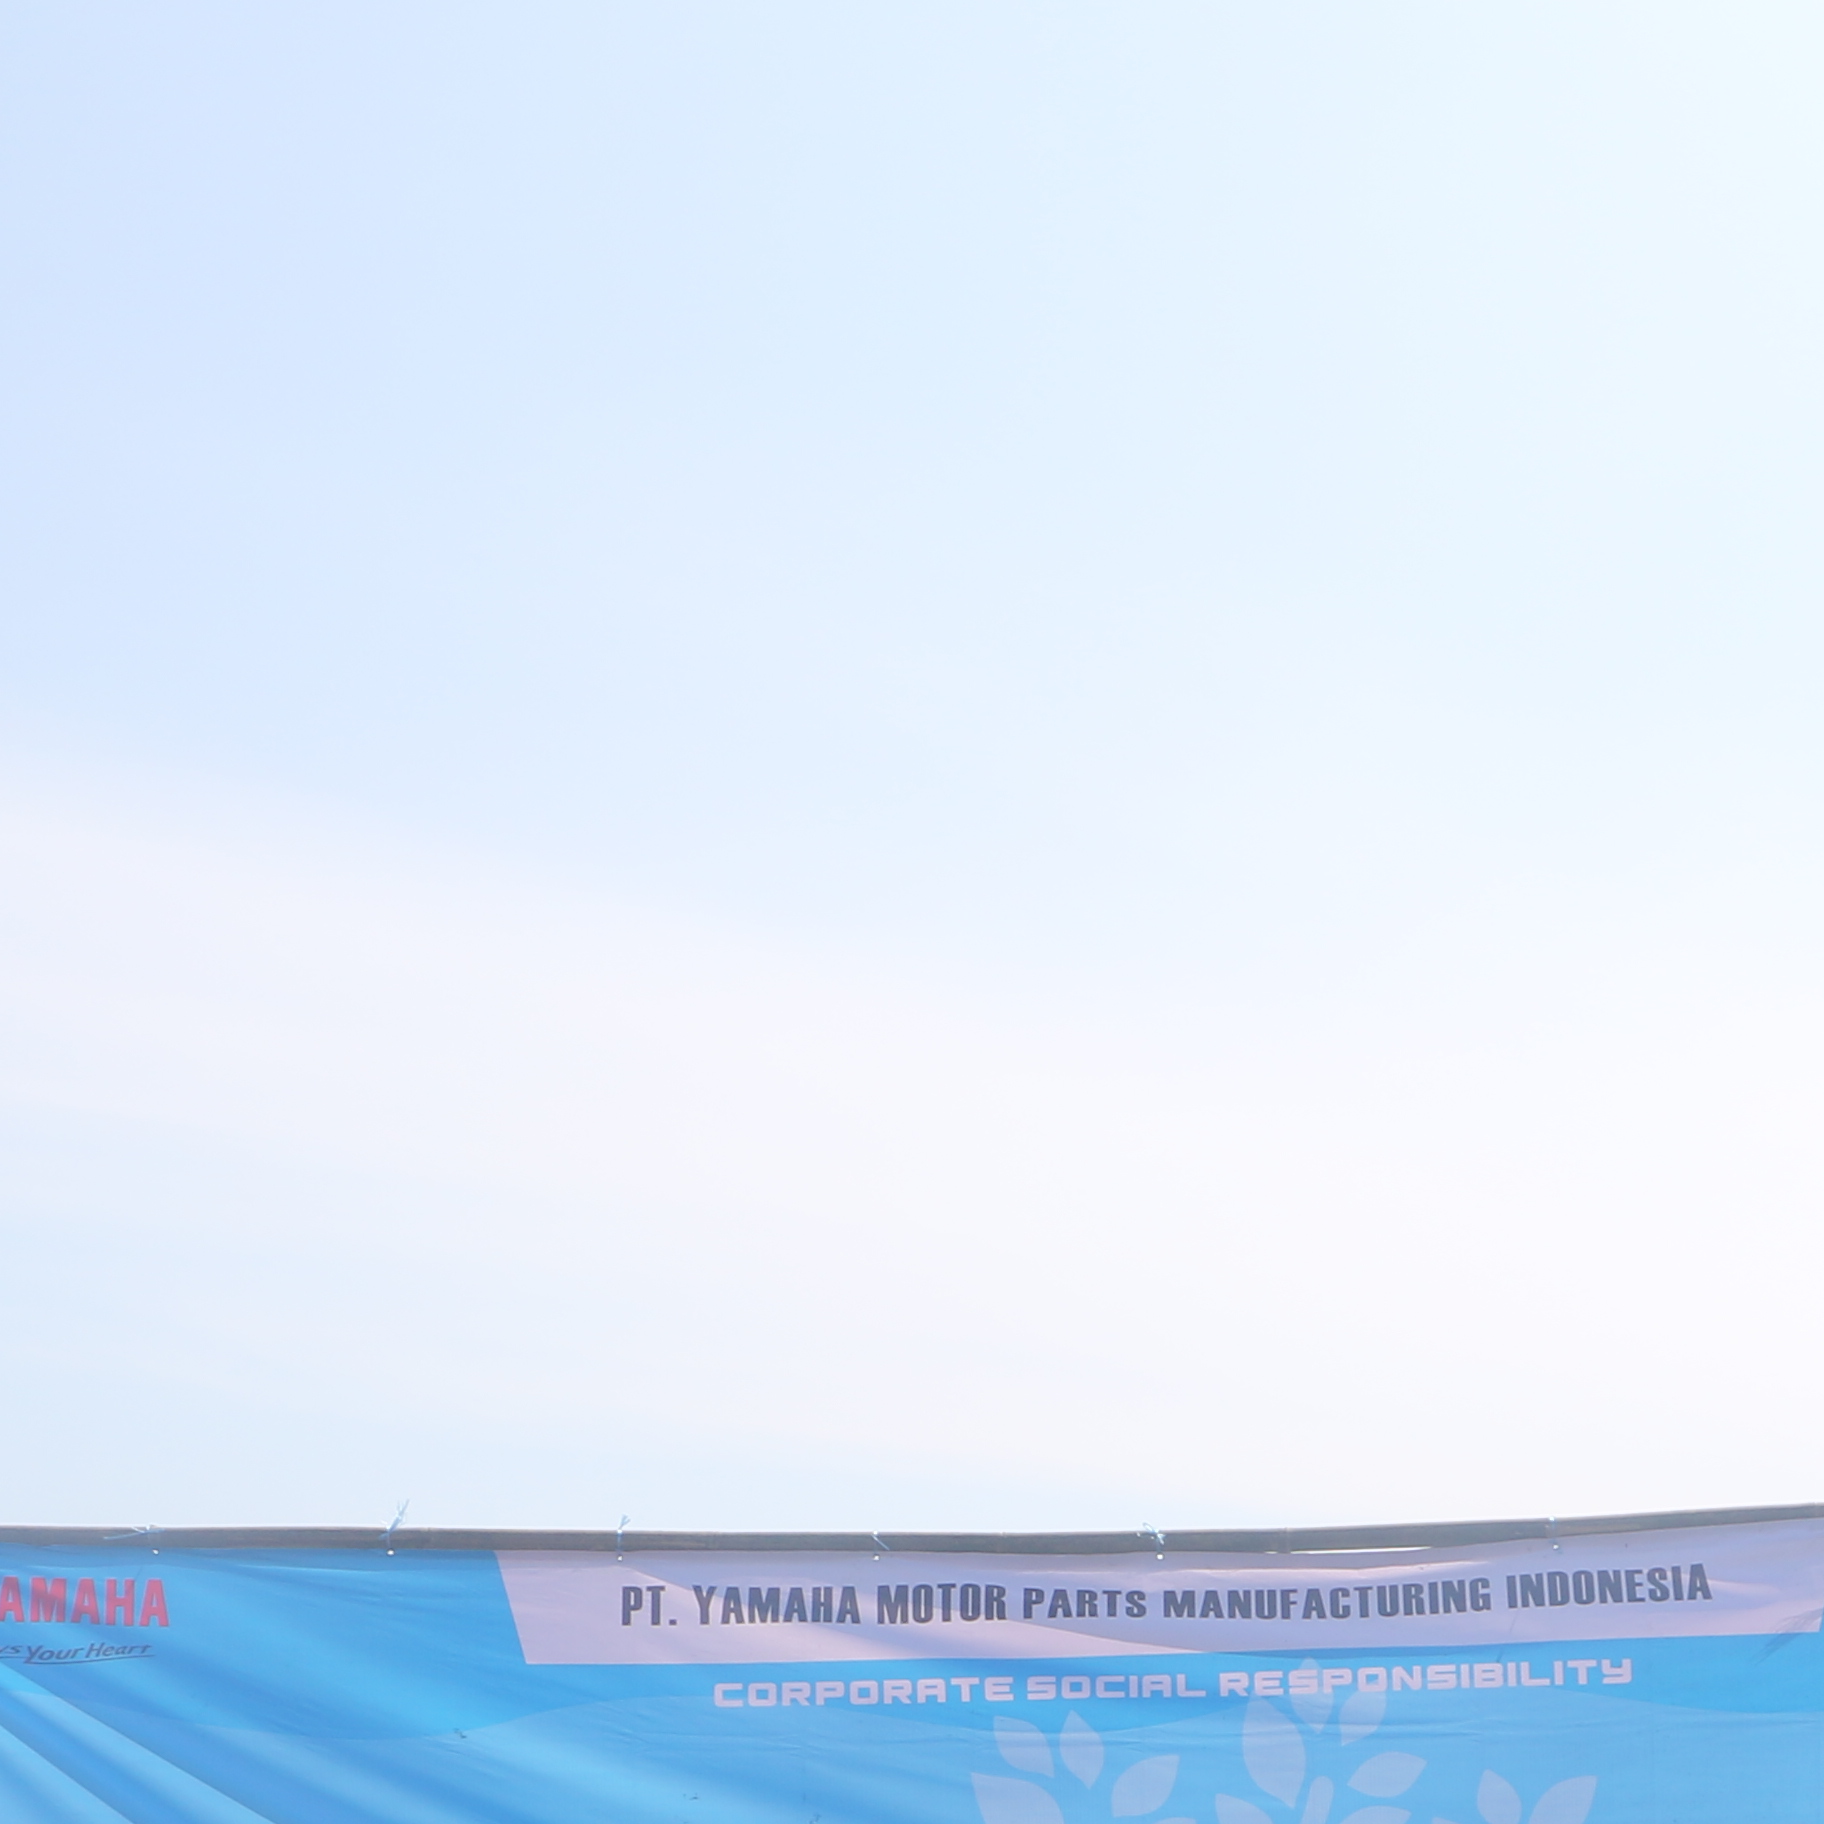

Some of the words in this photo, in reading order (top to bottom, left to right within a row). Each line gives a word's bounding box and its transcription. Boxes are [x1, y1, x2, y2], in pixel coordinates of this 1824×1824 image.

[621, 1585, 678, 1627] PT.
[692, 1584, 862, 1625] YAMAHA
[877, 1582, 1007, 1625] MOTOR
[1022, 1587, 1148, 1620] PARTS
[1162, 1577, 1492, 1620] MANUFACTURING
[1506, 1562, 1714, 1610] INDONESIA
[23, 1644, 88, 1664] Your
[85, 1642, 153, 1659] Heart
[713, 1676, 1015, 1708] CORPORATE
[1026, 1673, 1206, 1701] SOCIAL
[1219, 1658, 1633, 1698] RESPONSIBILITY
